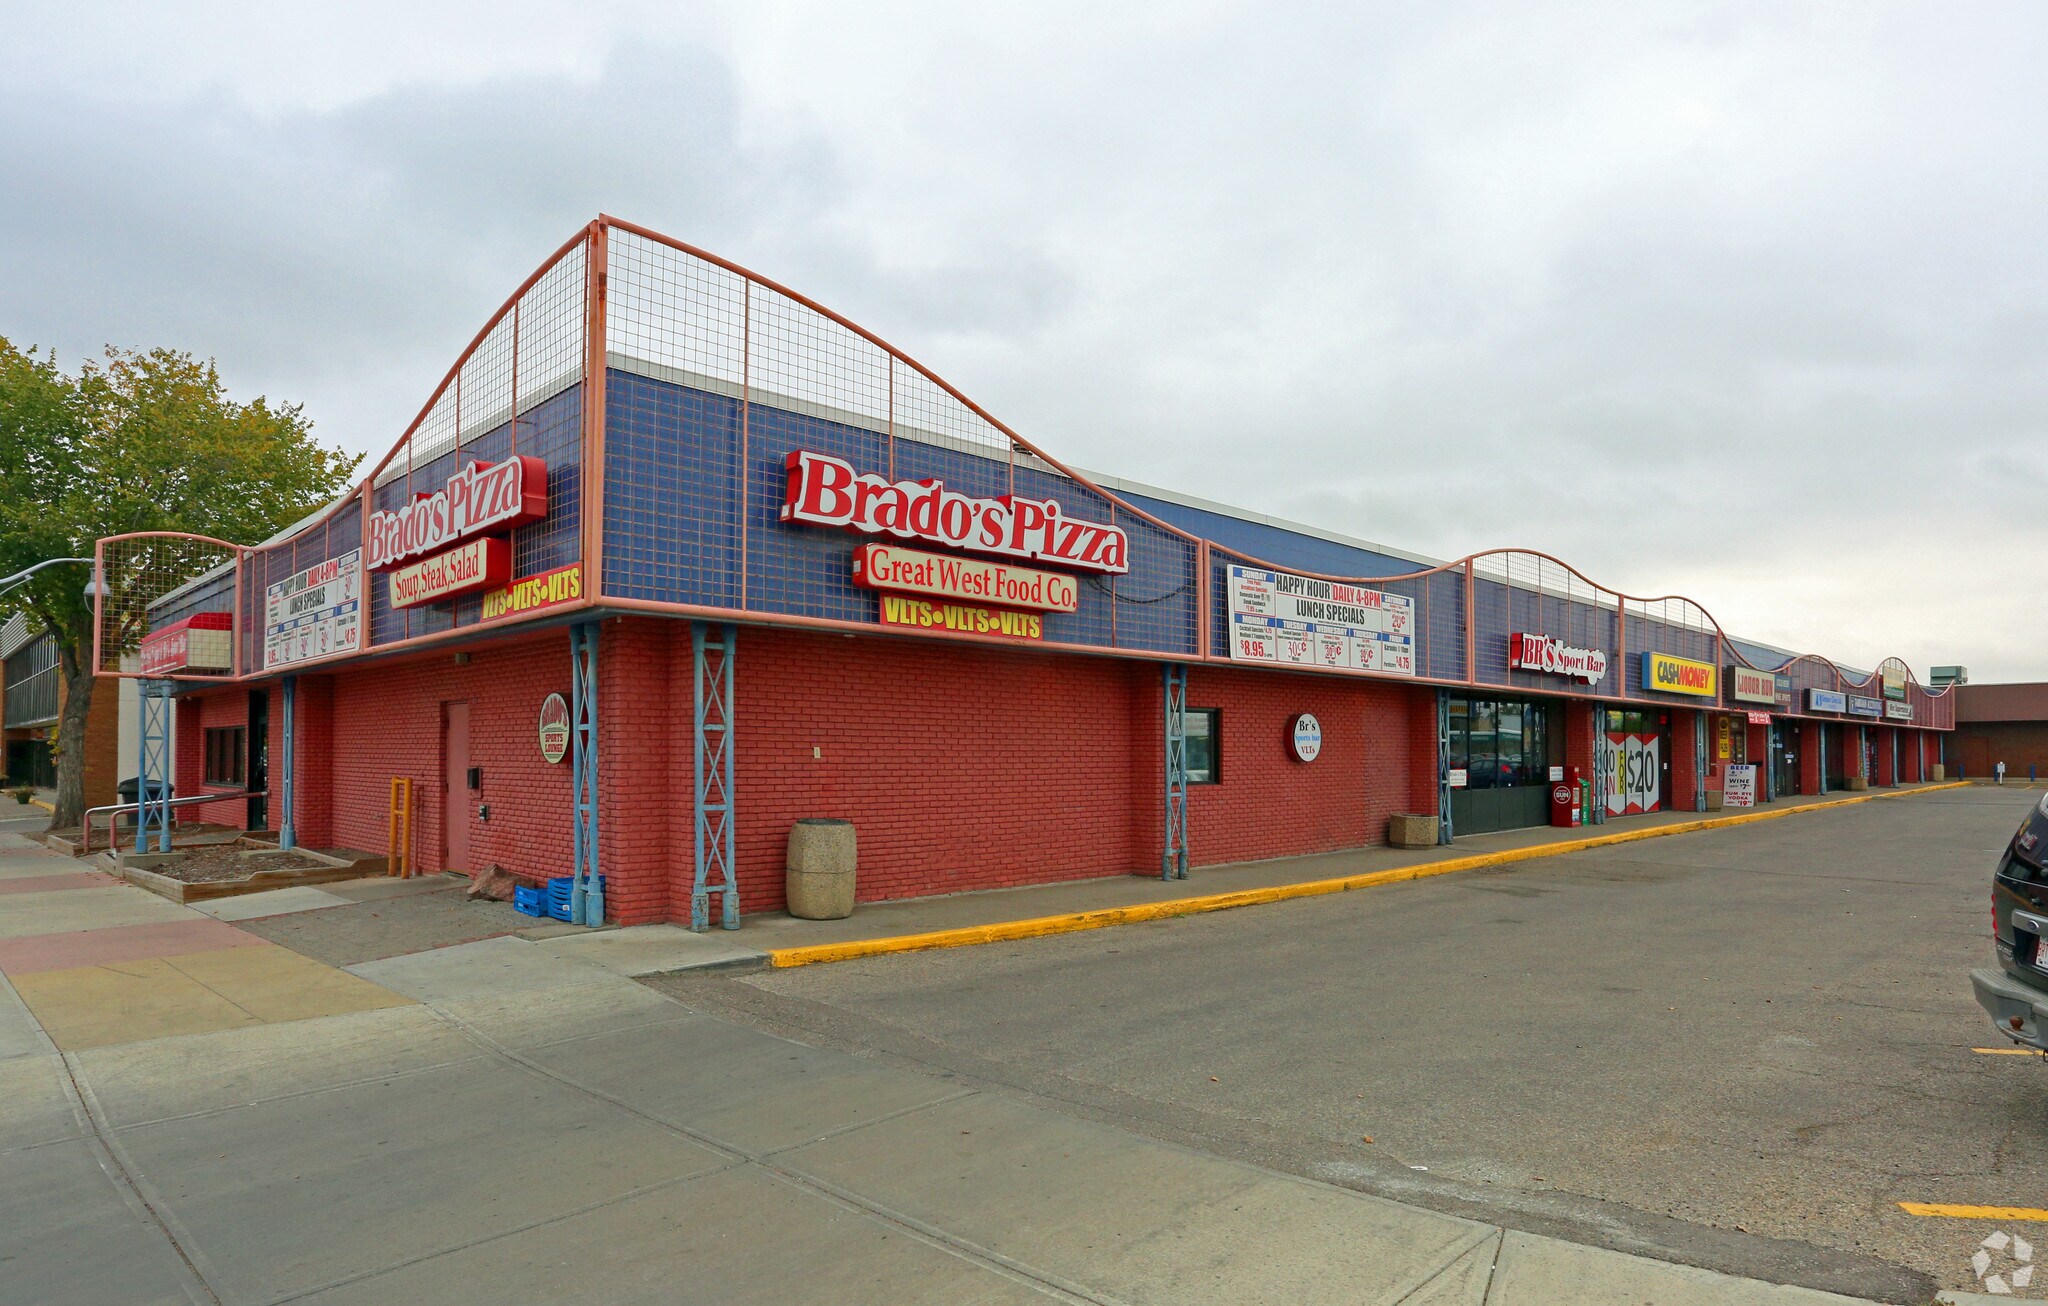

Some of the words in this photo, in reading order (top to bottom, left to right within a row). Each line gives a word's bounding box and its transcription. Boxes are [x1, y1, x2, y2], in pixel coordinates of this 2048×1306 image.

[368, 498, 445, 566] Brado's
[447, 462, 520, 536] Pizza
[800, 458, 1003, 549] Brado's
[1010, 503, 1126, 567] Pizza
[870, 549, 934, 588] Great
[937, 559, 991, 598] West
[994, 568, 1043, 603] Food
[1241, 569, 1267, 581] SUNDAY
[303, 586, 326, 611] SPECIALS
[1276, 573, 1305, 595] HAPPY
[1307, 582, 1331, 600] HOUR
[1332, 583, 1355, 604] DAILY
[1356, 589, 1381, 608] 4-8PM
[883, 596, 933, 628] VLTS
[942, 604, 990, 633] VLTS
[1000, 611, 1041, 639] VLTS
[1296, 599, 1325, 619] LUNCH
[1326, 603, 1365, 626] SPECIALS
[1240, 639, 1265, 658] $8.95
[1522, 636, 1555, 669] BR'S
[1557, 648, 1585, 671] Sport
[1586, 653, 1605, 674] Bar
[1395, 655, 1410, 670] $4.75
[1737, 673, 1760, 696] LIQUOR
[545, 733, 563, 743] SPORTS
[1299, 720, 1316, 731] Br's
[545, 743, 563, 753] LOUNGE
[1627, 749, 1655, 794] $20
